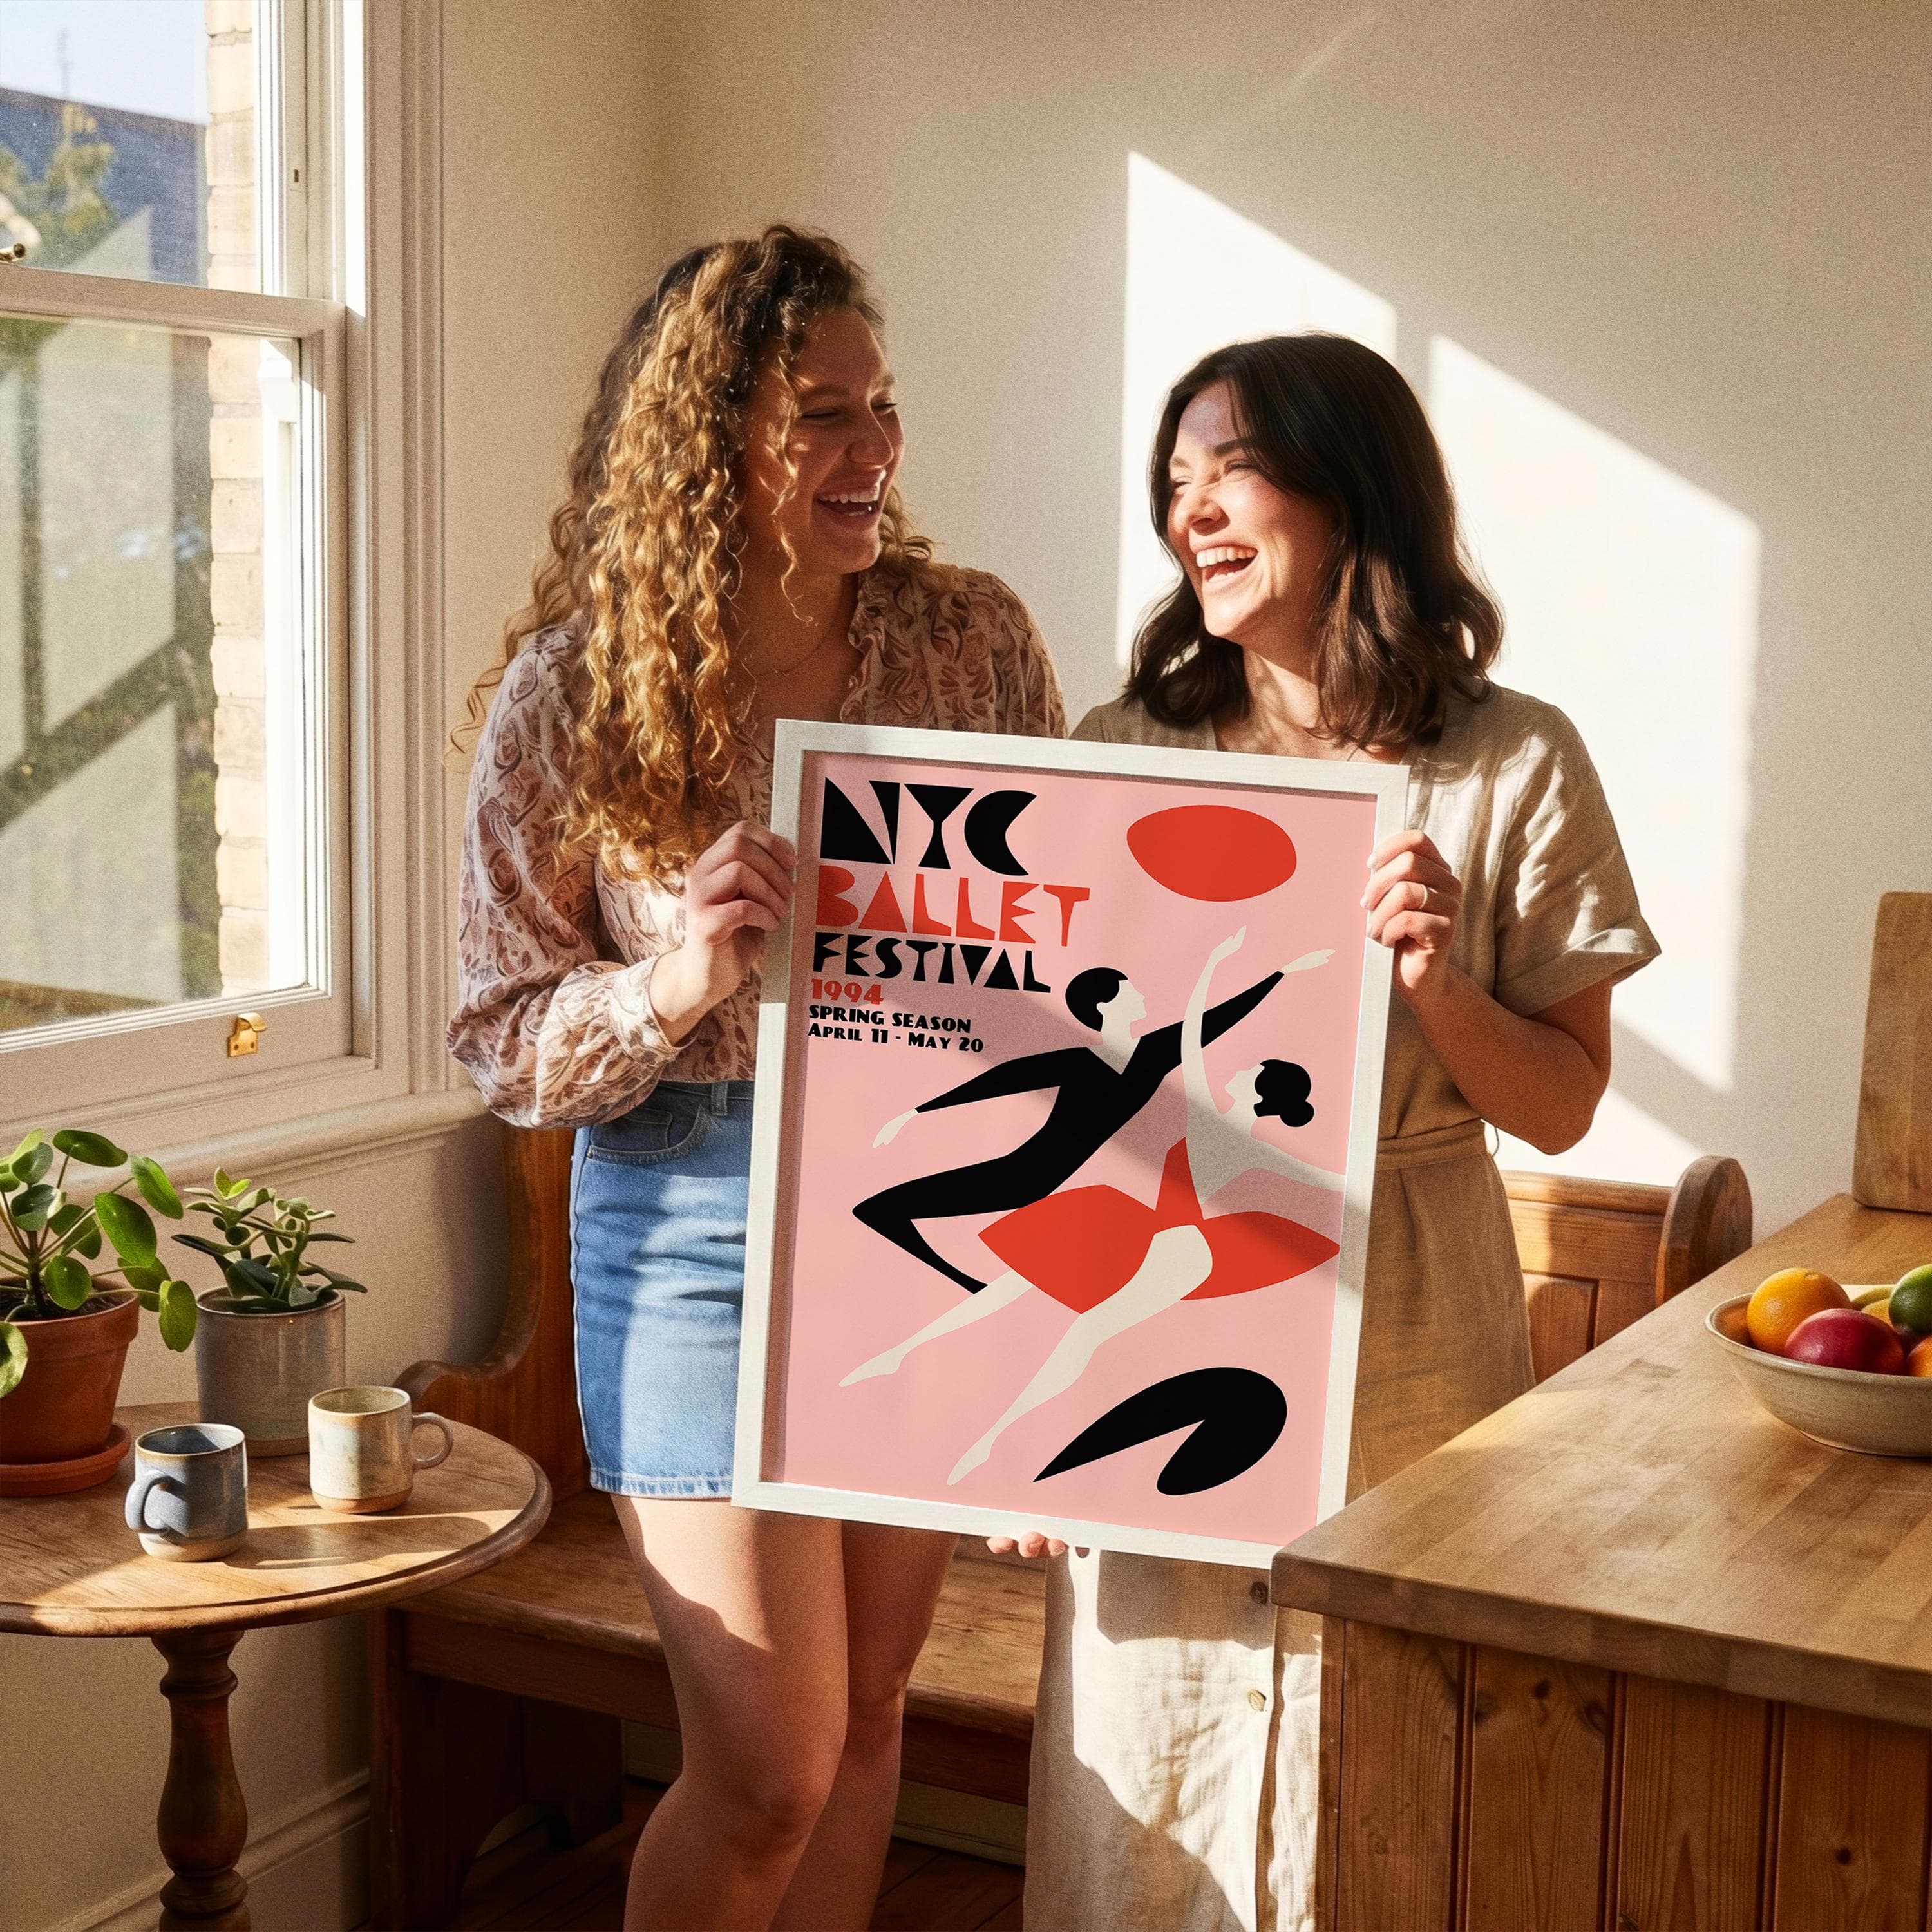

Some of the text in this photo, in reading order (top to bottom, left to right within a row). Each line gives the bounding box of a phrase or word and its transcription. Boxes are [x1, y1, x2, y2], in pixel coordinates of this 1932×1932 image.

[820, 777, 1037, 876] NYC
[815, 865, 1090, 947] BALLET
[813, 931, 1051, 993] FESTIVAL
[811, 978, 884, 1005] 1994
[808, 1023, 863, 1041] APRIL
[871, 1028, 888, 1043] 11
[908, 1032, 951, 1050] MAY
[958, 1037, 984, 1053] 20
[809, 1005, 971, 1034] SPRING SEASON
